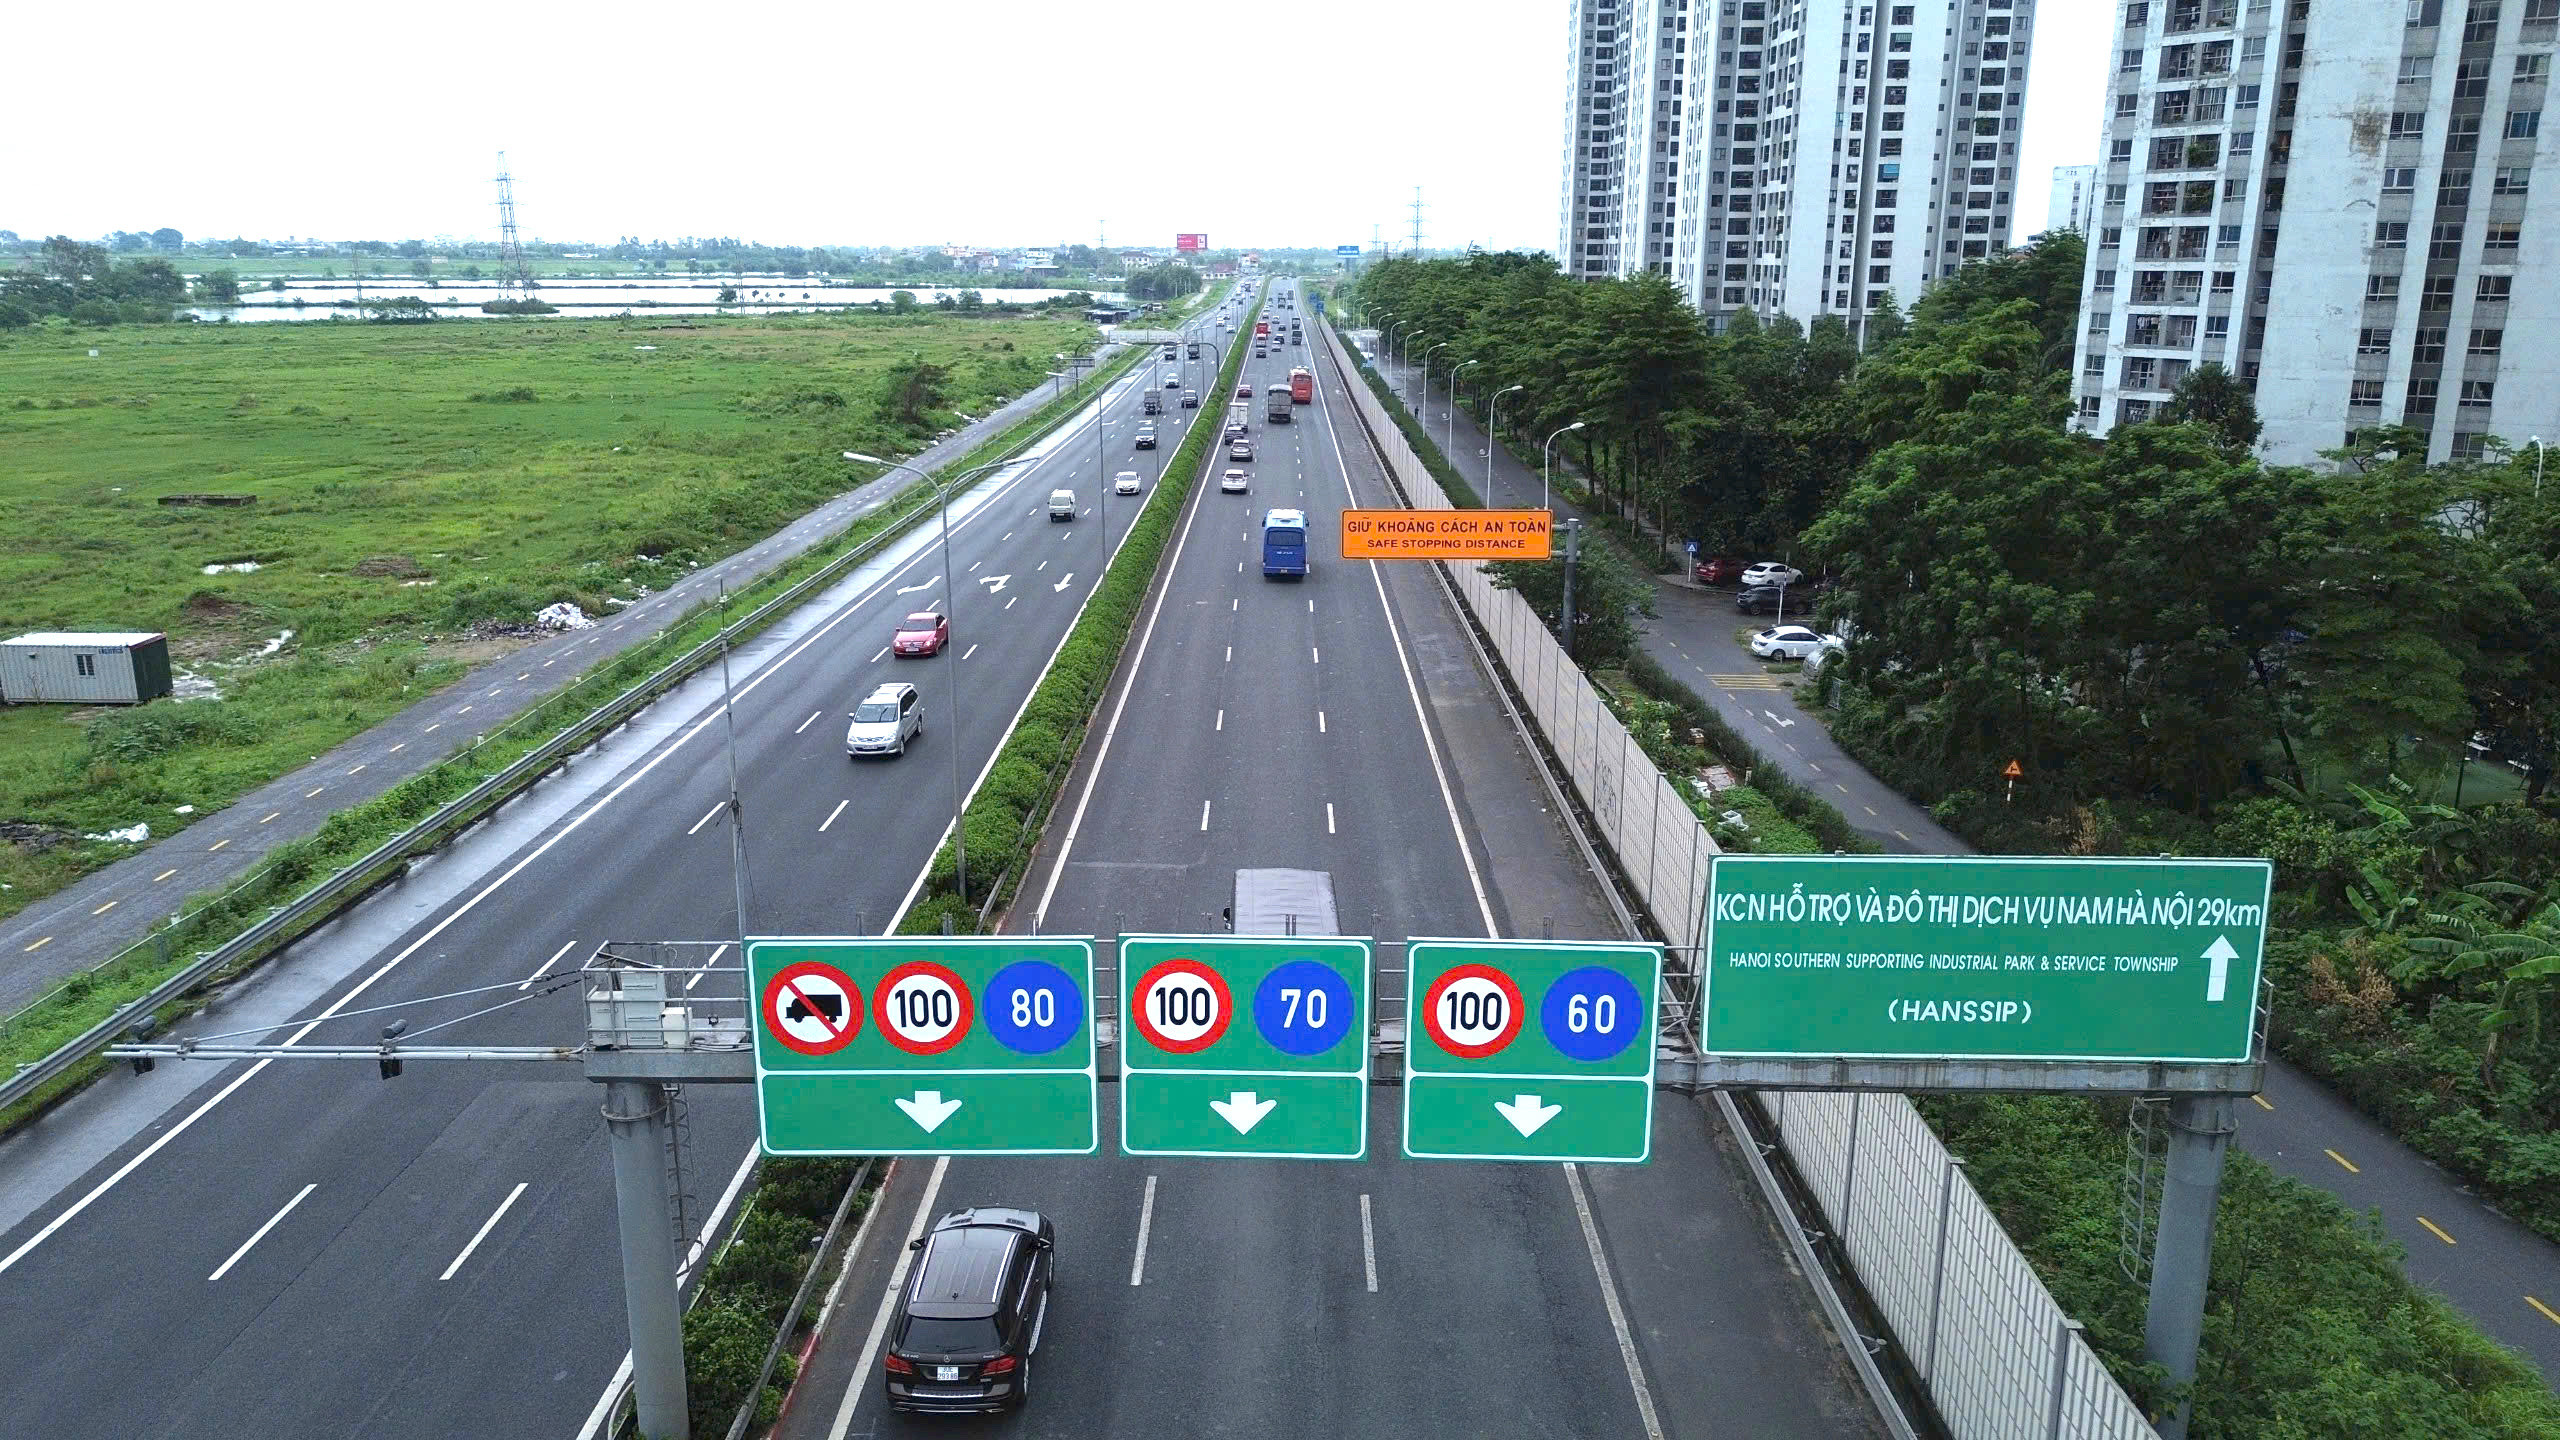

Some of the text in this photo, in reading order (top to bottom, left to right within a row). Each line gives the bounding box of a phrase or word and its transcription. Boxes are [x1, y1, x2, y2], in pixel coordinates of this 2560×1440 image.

[1347, 516, 1372, 533] GIỮ
[1440, 517, 1478, 533] CÁCH
[1484, 521, 1504, 533] AN
[1509, 517, 1546, 533] TOÀN
[1367, 539, 1525, 549] SAFE STOPPING DISTANCE
[1716, 882, 2261, 930] KCN HỖ TRỢ VÀ ĐÔ THỊ DỊCH VỤ NAM HÀ NỘI 29km
[1729, 952, 2179, 972] HANOI SOUTHERN SUPPORTING INDUSTRIAL PARK & SERVICE TOWNSHIP
[894, 989, 953, 1028] 100
[1011, 988, 1055, 1028] 80
[1155, 987, 1211, 1026] 100
[1281, 988, 1327, 1029] 70
[1446, 991, 1502, 1031] 100
[1568, 993, 1616, 1034] 60
[1888, 998, 2032, 1024] (HANSSIP)
